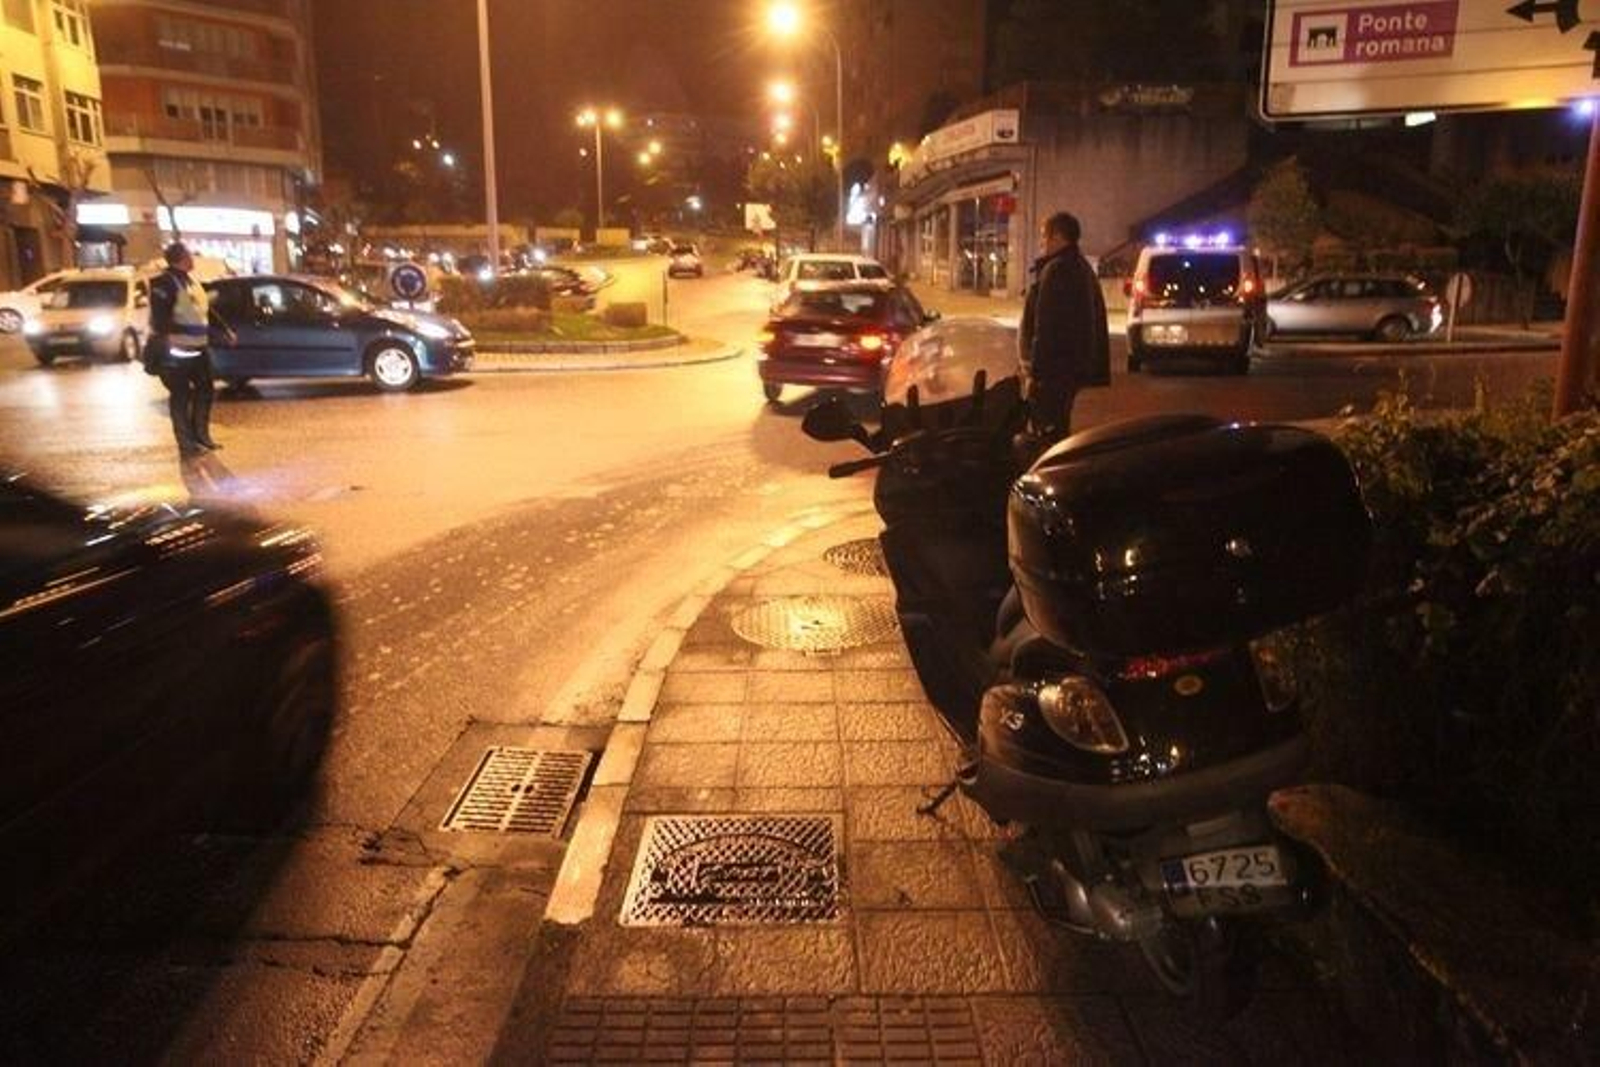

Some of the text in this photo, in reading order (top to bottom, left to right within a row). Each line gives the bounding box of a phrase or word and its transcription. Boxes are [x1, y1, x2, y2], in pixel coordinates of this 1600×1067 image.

[1358, 11, 1428, 33] Ponte
[1355, 35, 1445, 56] romana
[1189, 852, 1276, 886] 6725
